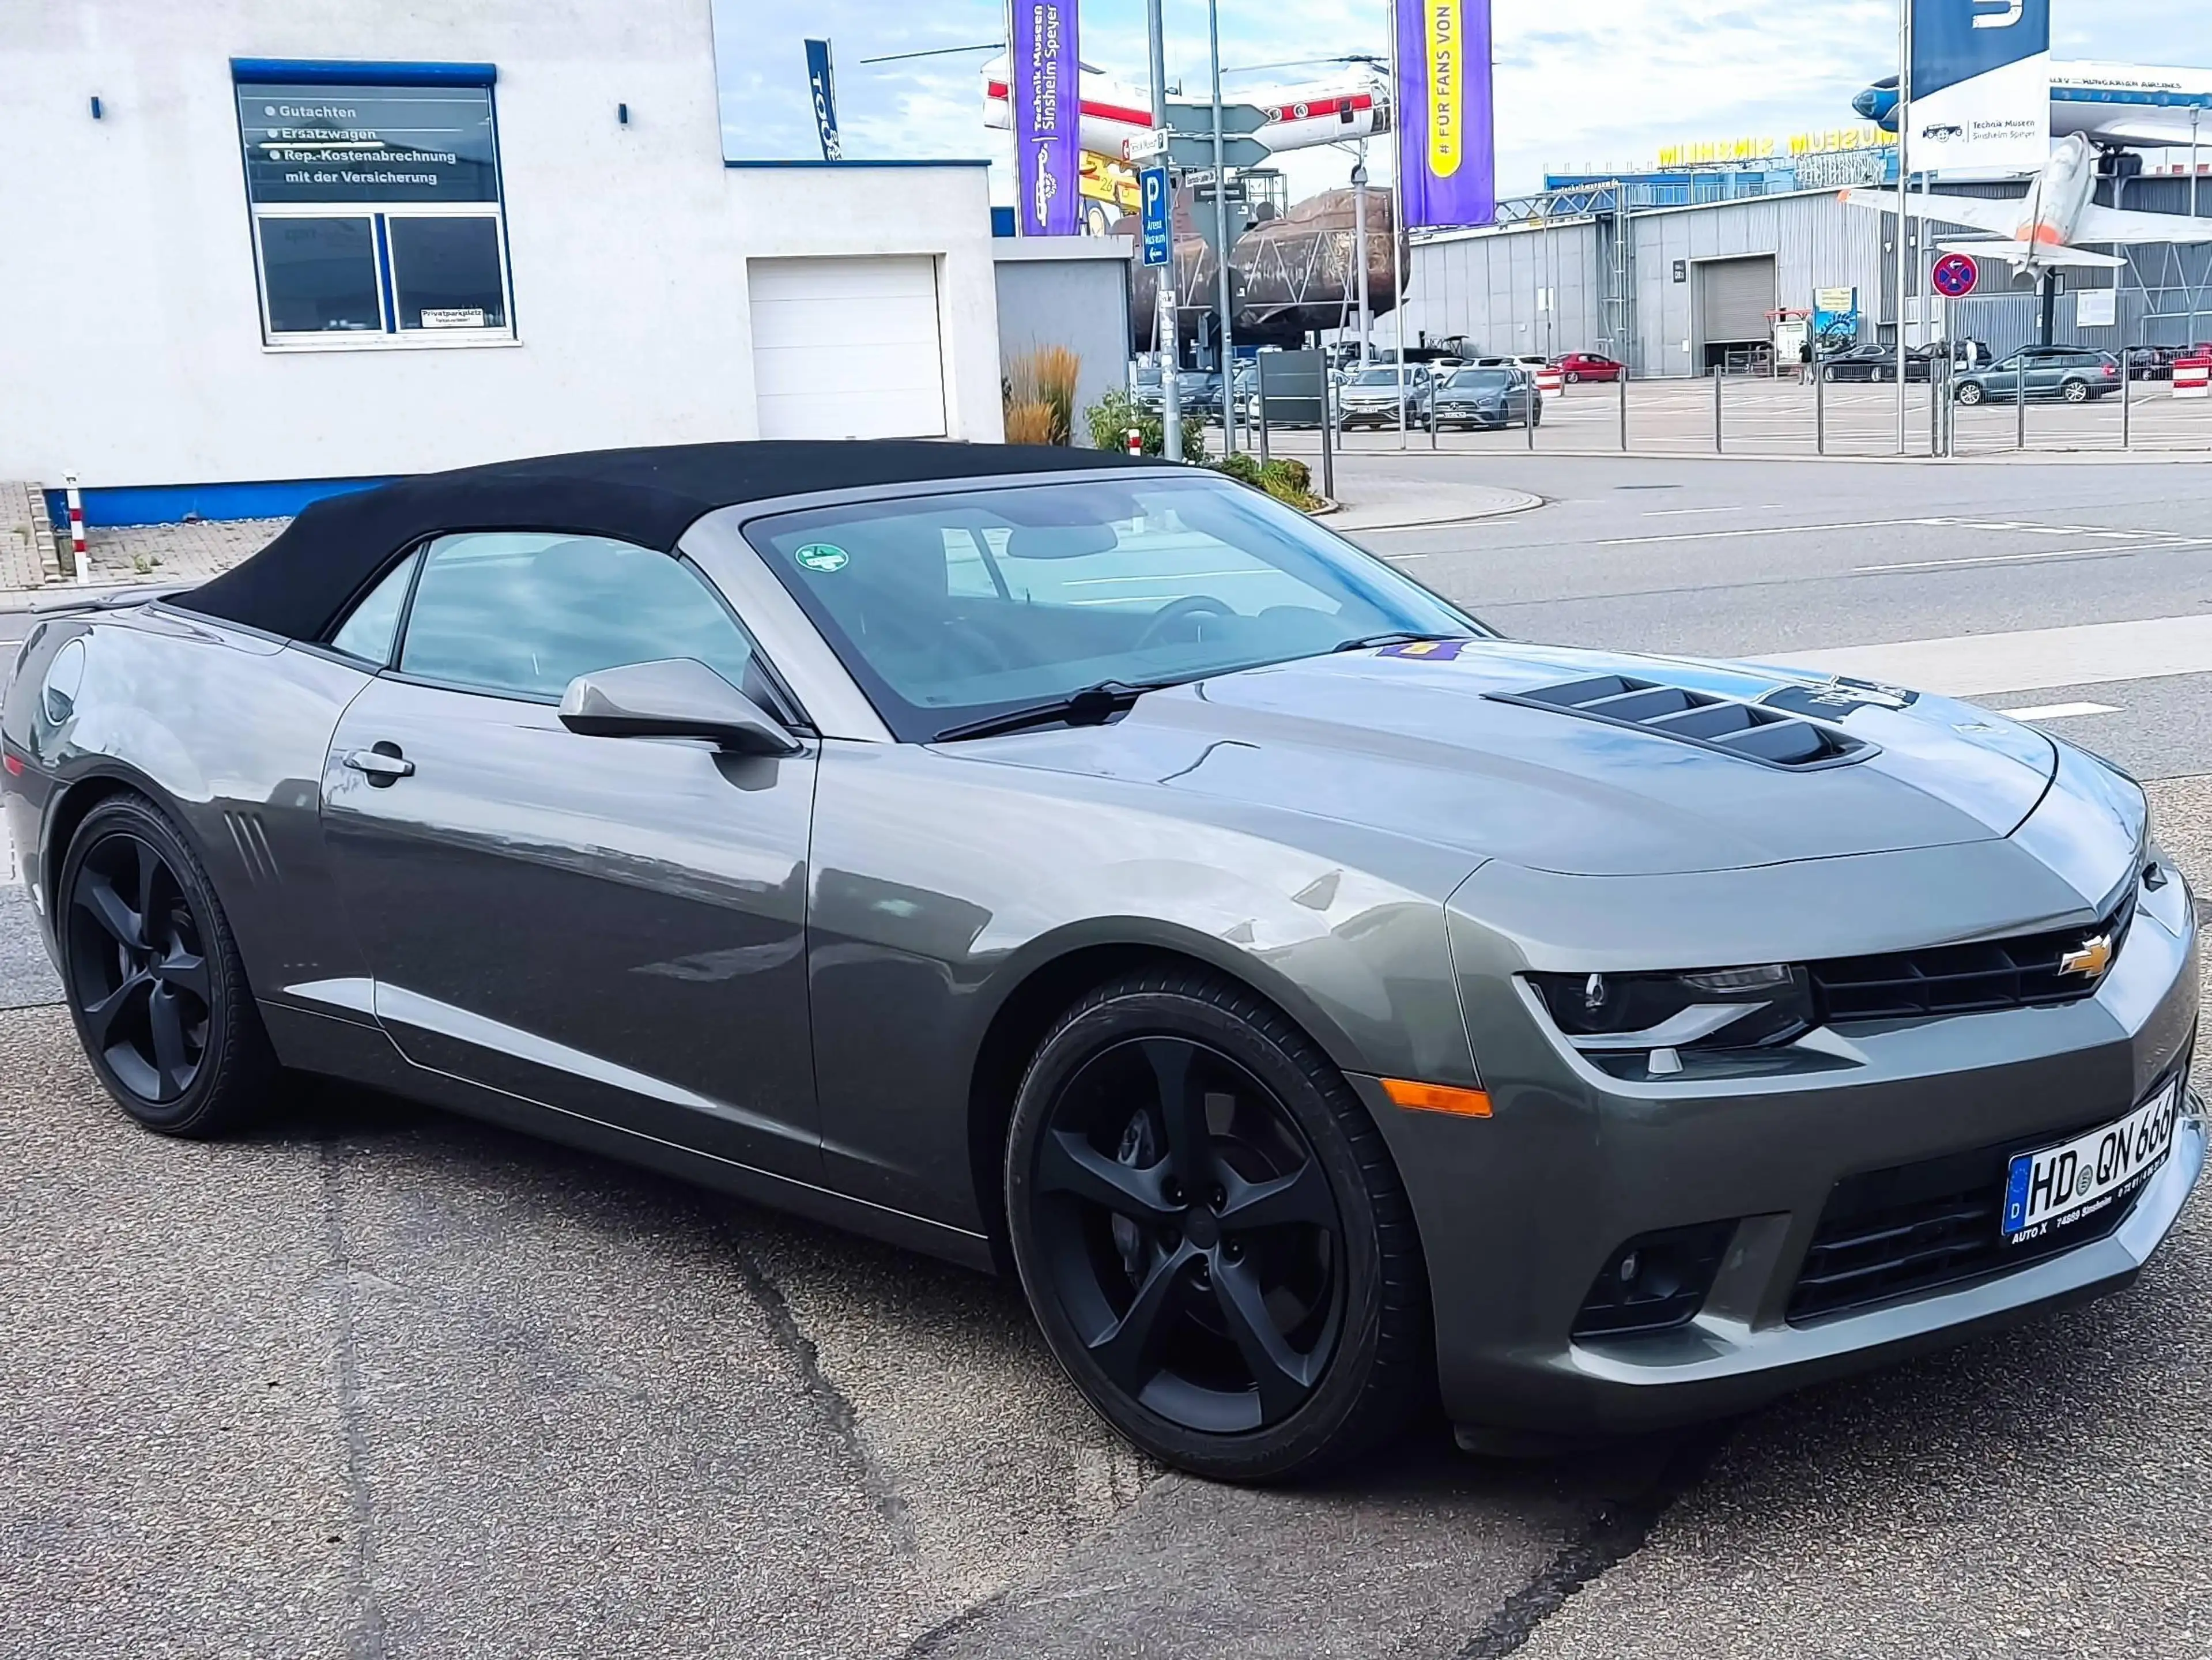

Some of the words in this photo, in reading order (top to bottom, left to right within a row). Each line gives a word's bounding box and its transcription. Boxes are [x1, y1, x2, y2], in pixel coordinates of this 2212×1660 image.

[1033, 5, 1043, 67] Museen
[1044, 4, 1060, 58] Speyer
[1436, 6, 1451, 45] VON
[1436, 50, 1450, 96] FANS
[279, 105, 357, 119] Gutachten
[1033, 69, 1043, 132] Technik
[1042, 61, 1057, 131] Sinsheim
[282, 128, 376, 141] Ersatzwagen
[1436, 103, 1450, 137] FÜR
[1973, 119, 2002, 129] Technik
[2004, 119, 2035, 128] Museen
[284, 149, 457, 165] Rep.-Kostenabrechnung
[285, 170, 311, 183] mit
[314, 171, 337, 183] der
[341, 171, 437, 186] Versicherung
[1100, 177, 1113, 192] 26
[1147, 176, 1159, 217] P
[2028, 1150, 2078, 1217] HD
[2096, 1121, 2135, 1186] QN
[2135, 1092, 2173, 1163] 666
[2010, 1202, 2020, 1219] D
[2011, 1227, 2039, 1244] AUTO
[2039, 1221, 2048, 1235] X
